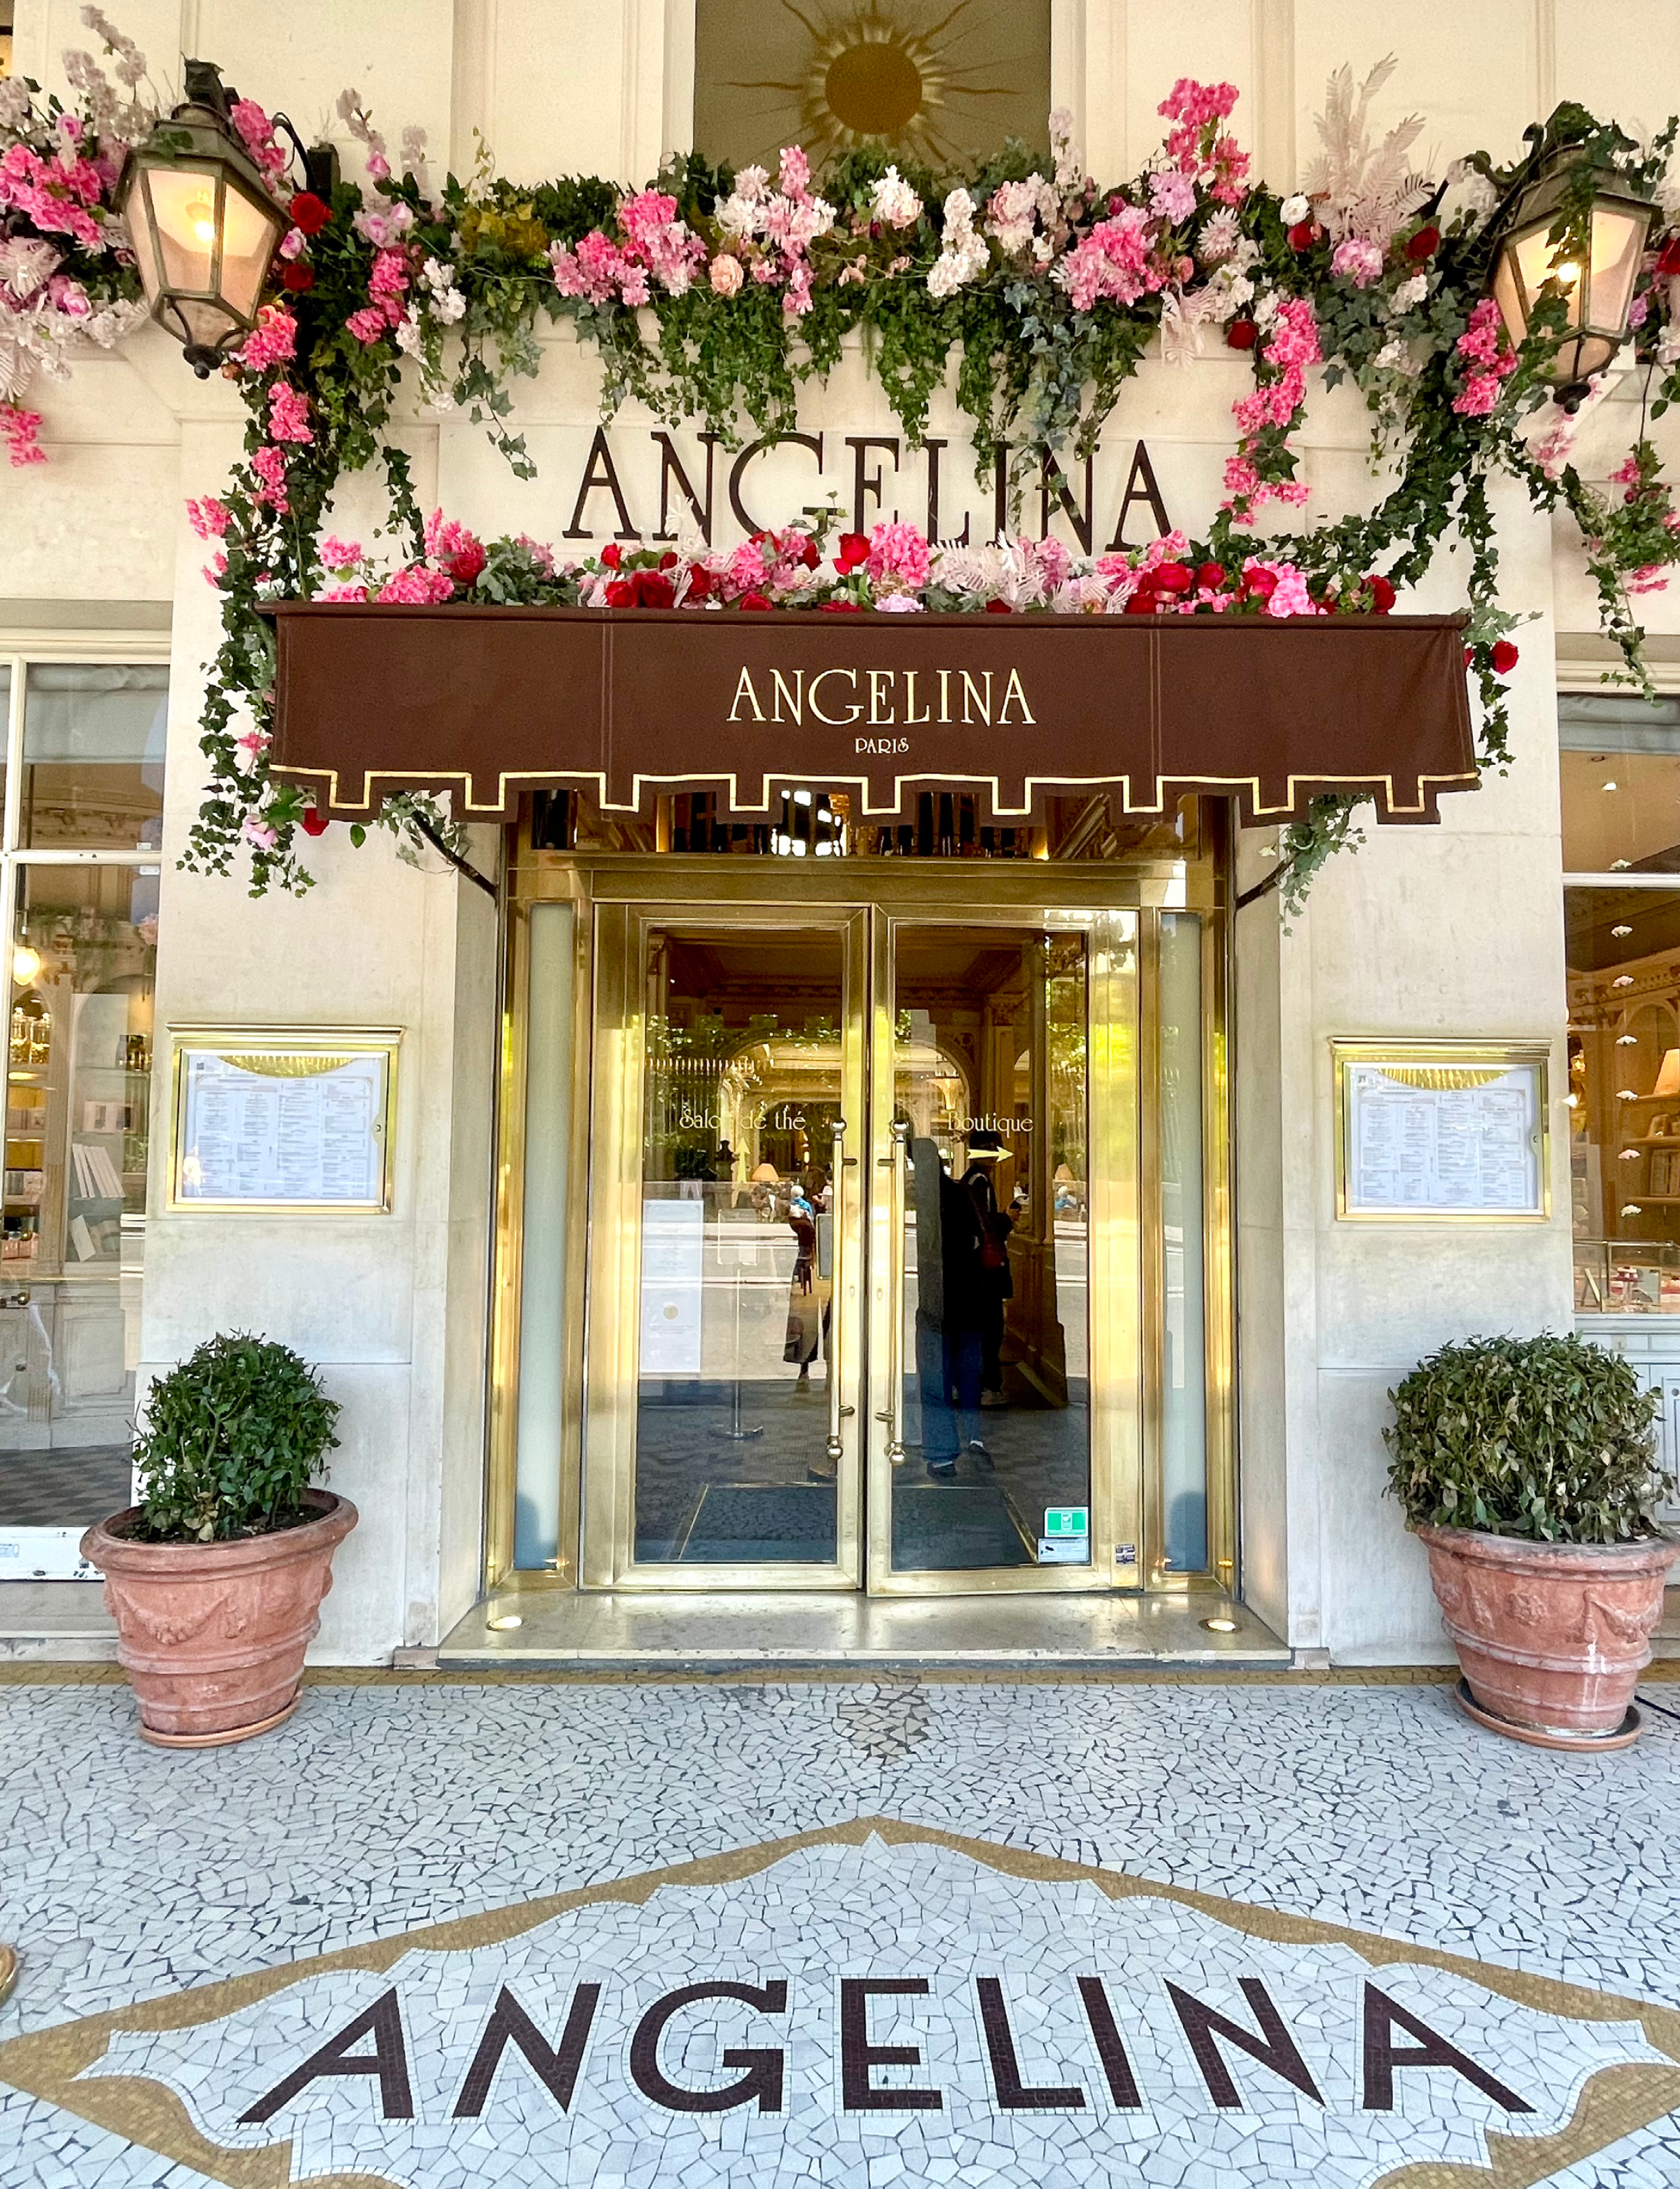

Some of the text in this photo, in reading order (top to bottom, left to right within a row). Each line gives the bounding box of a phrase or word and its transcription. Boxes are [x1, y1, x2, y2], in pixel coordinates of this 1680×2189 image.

[562, 426, 1173, 556] ANGELINA
[726, 665, 1037, 726] ANGELINA
[854, 737, 910, 754] PARIS
[679, 1108, 733, 1129] Salo
[774, 1110, 806, 1130] thé
[947, 1111, 1034, 1138] Boutique
[235, 1975, 1541, 2126] ANGELINA
